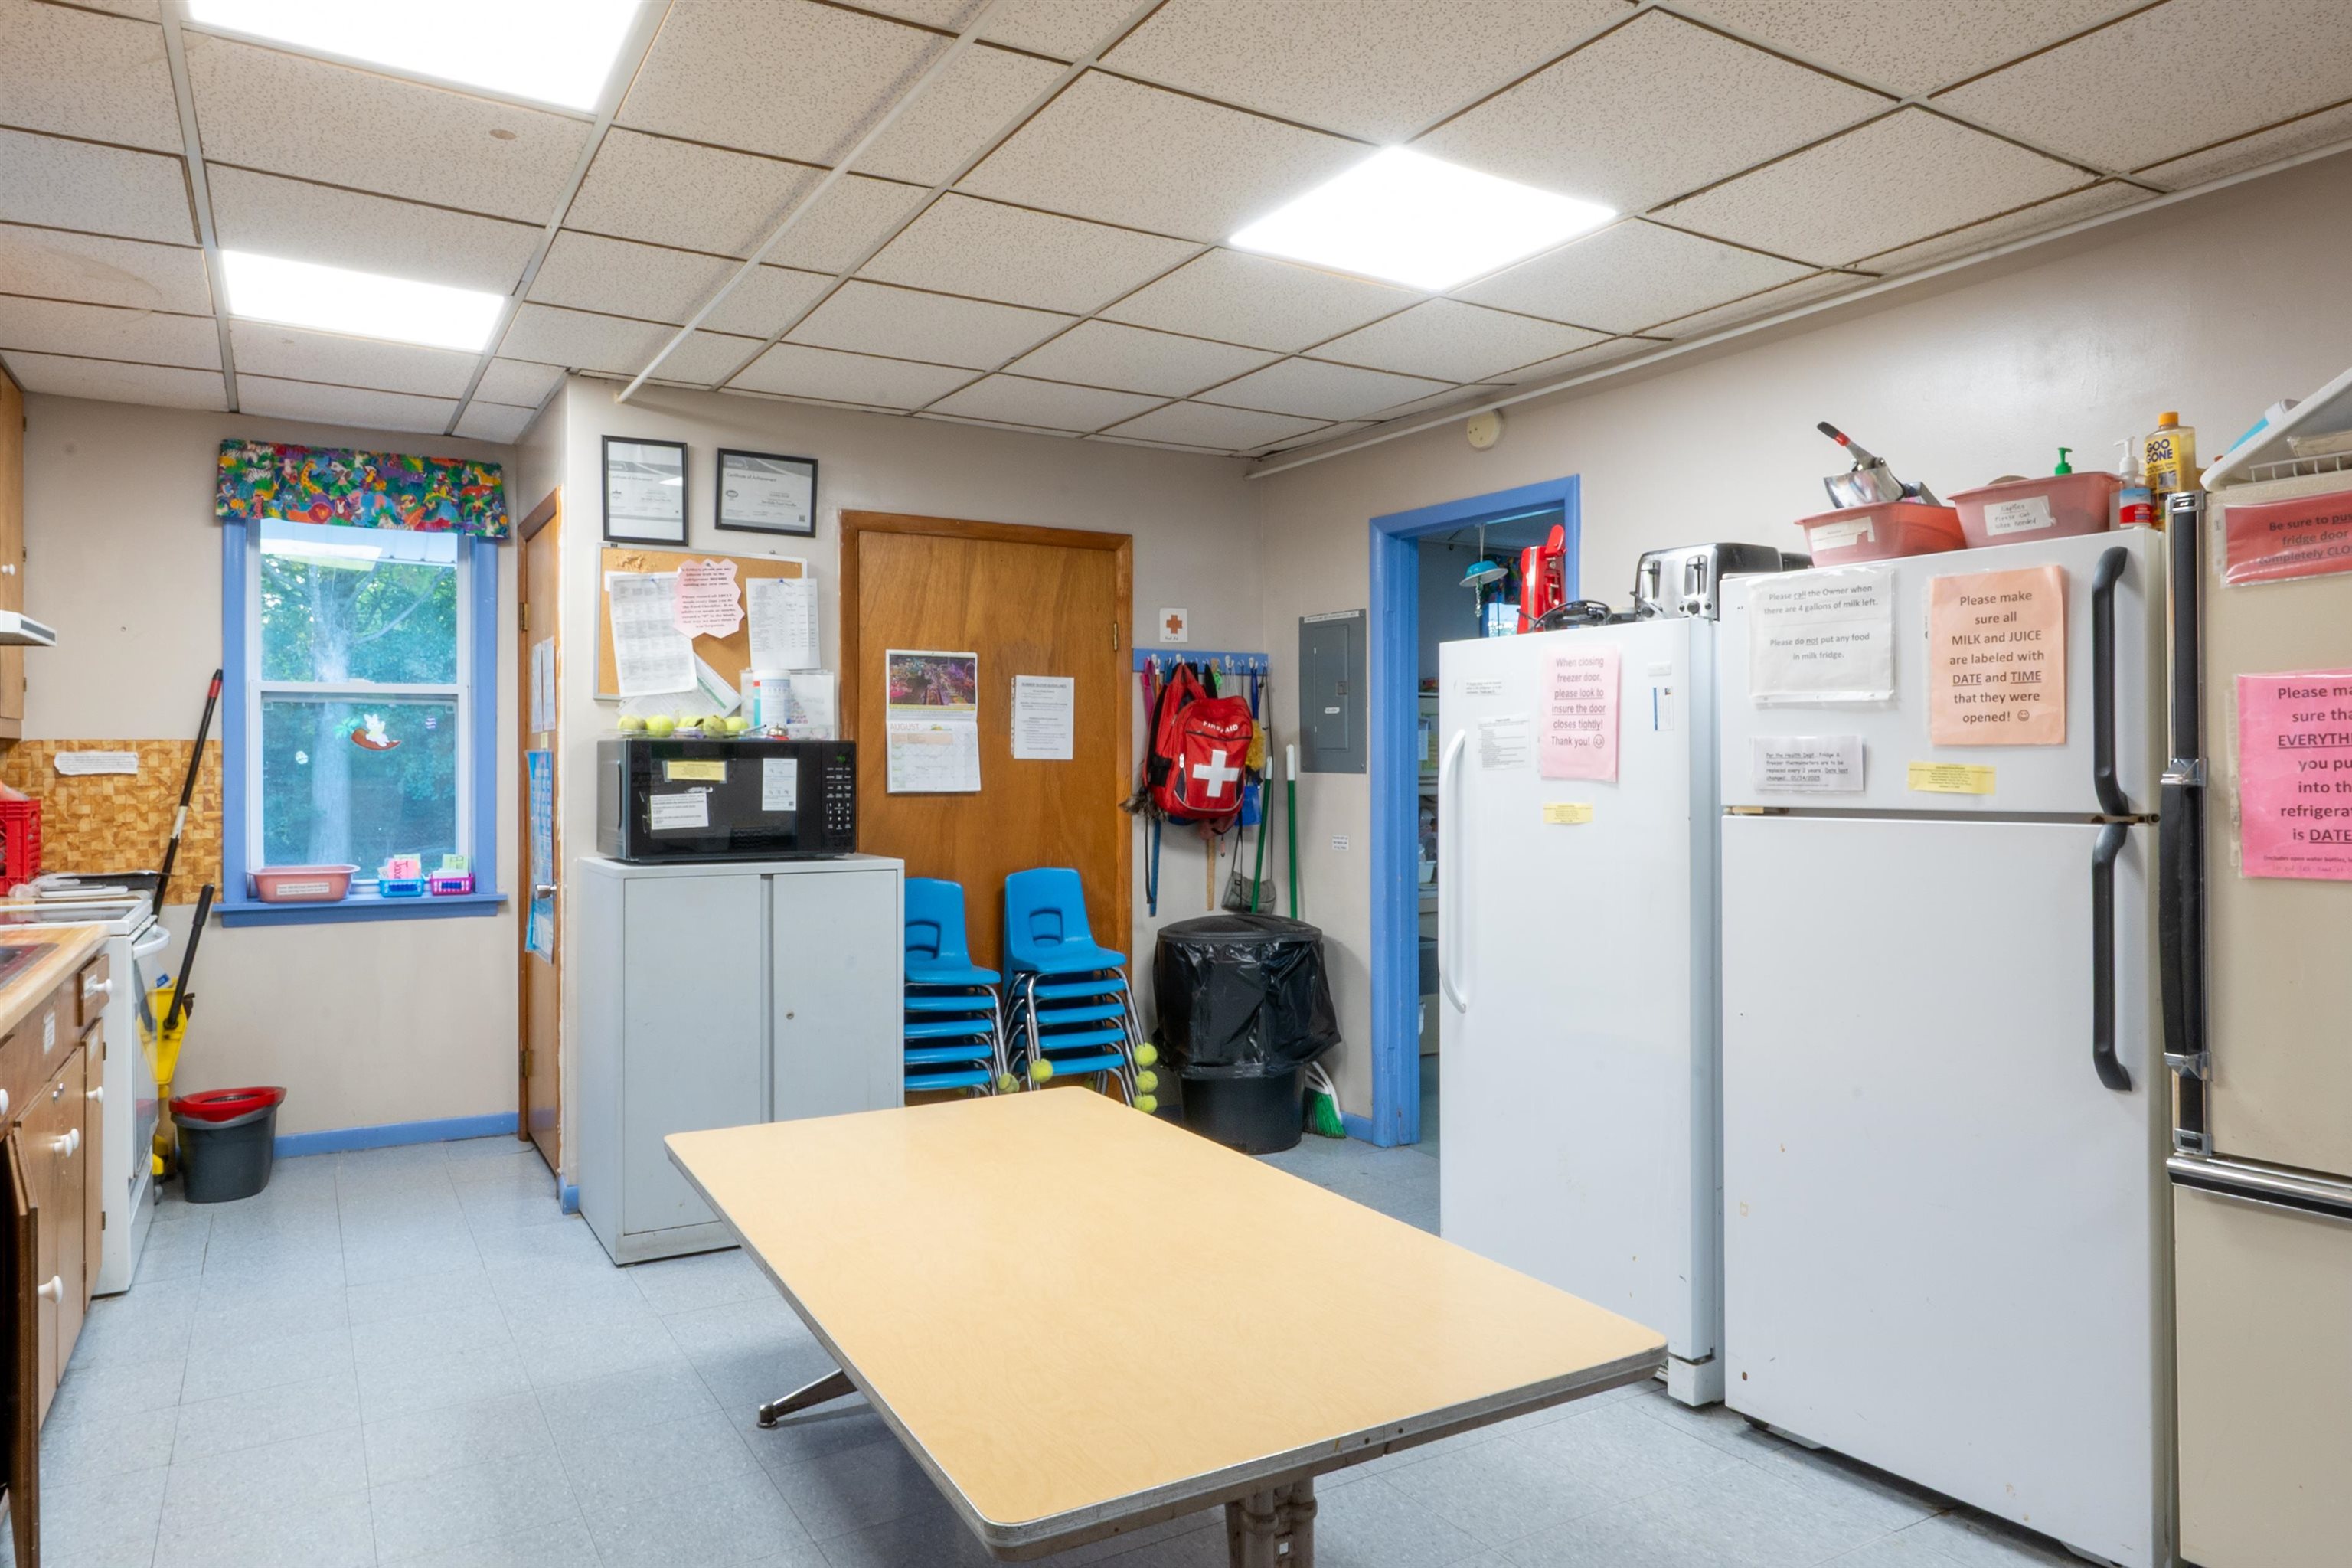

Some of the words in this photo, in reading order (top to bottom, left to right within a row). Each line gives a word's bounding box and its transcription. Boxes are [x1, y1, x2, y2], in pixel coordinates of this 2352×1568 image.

[2147, 439, 2170, 453] GOO
[2146, 449, 2173, 464] GONE
[2269, 522, 2283, 531] Be
[2287, 519, 2312, 528] sure
[2283, 534, 2316, 545] fridge
[2321, 531, 2348, 541] door
[2327, 545, 2352, 555] CLO
[1794, 591, 1806, 599] call
[1822, 587, 1848, 596] Owner
[1850, 585, 1872, 593] when
[1960, 596, 1997, 606] Please
[2000, 591, 2032, 603] make
[1805, 603, 1831, 613] gallons
[1975, 615, 2000, 625] sure
[2003, 611, 2017, 622] all
[1806, 637, 1818, 645] not
[1821, 636, 1834, 645] put
[1851, 632, 1870, 641] food
[1952, 635, 1981, 645] MILK
[1984, 632, 2005, 644] and
[2009, 630, 2042, 642] JUICE
[1802, 651, 1817, 659] milk
[1950, 657, 1968, 665] are
[1971, 652, 2014, 664] labeled
[2017, 650, 2044, 662] with
[1556, 658, 1576, 668] When
[1578, 658, 1604, 668] closing
[1557, 674, 1582, 683] freezer
[1952, 674, 1981, 686] DATE
[1985, 672, 2007, 683] and
[2011, 671, 2042, 684] TIME
[1554, 689, 1578, 700] please
[1579, 688, 1594, 697] look
[1596, 688, 1604, 697] to
[1954, 693, 1977, 704] that
[1980, 692, 2006, 704] they
[2009, 693, 2040, 702] were
[2278, 687, 2328, 699] Please
[1552, 704, 1574, 714] insure
[1576, 704, 1587, 713] the
[1589, 704, 1606, 713] door
[1962, 711, 2011, 724] opened!
[2292, 712, 2325, 723] sure
[1225, 724, 1238, 733] AID
[1553, 719, 1576, 729] closes
[1579, 719, 1603, 730] tightly!
[1551, 736, 1573, 746] Thank
[1574, 737, 1590, 749] you!
[2298, 760, 2328, 772] you
[2298, 781, 2330, 793] into
[2293, 828, 2304, 840] is
